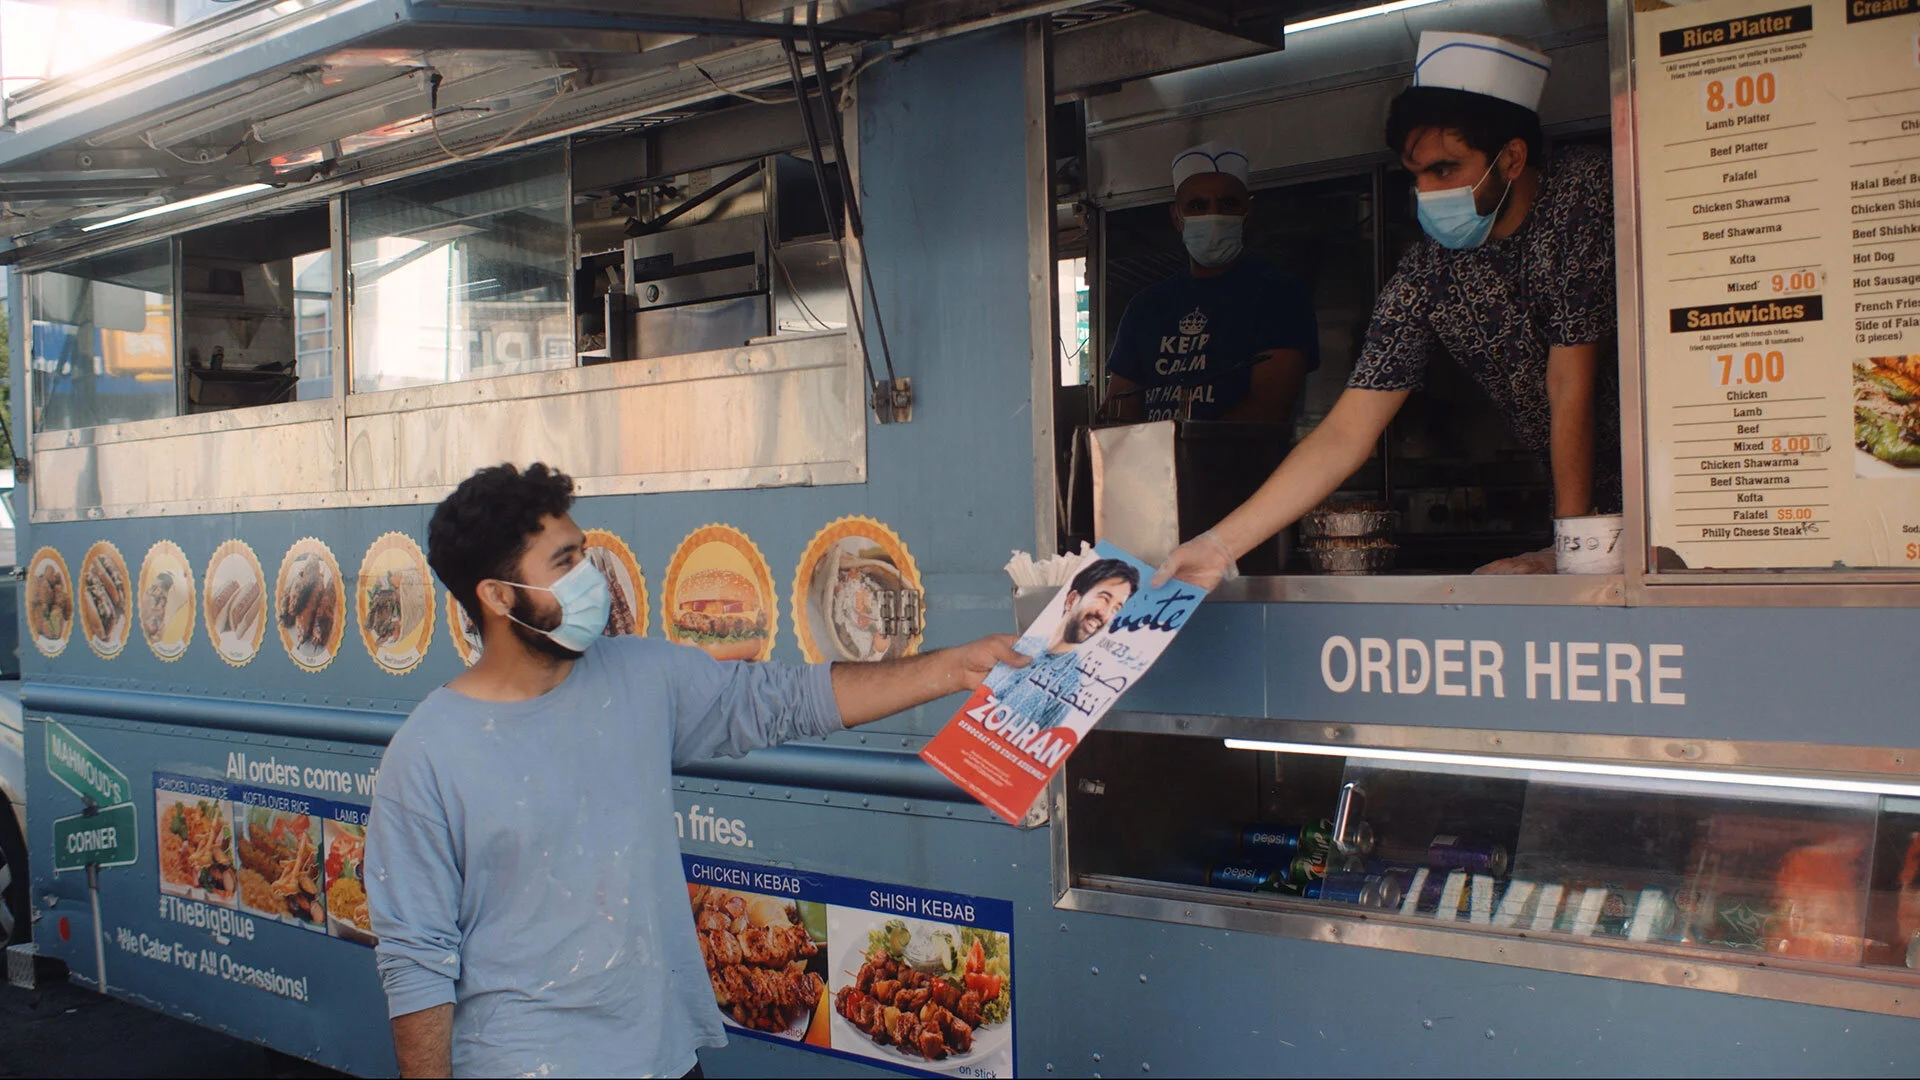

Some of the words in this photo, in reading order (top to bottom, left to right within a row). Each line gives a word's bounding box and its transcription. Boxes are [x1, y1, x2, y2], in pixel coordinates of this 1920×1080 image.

[1683, 31, 1724, 48] Rice
[1730, 14, 1793, 40] Platter
[1717, 55, 1737, 64] brown
[1746, 48, 1768, 59] yellow
[1706, 72, 1775, 112] 8.00
[1706, 118, 1735, 131] Lamb
[1737, 113, 1770, 127] Platter
[1710, 147, 1732, 158] Beef
[1735, 141, 1768, 153] Platter
[1722, 170, 1757, 183] Falafel
[1850, 179, 1879, 191] Halal
[1882, 174, 1906, 187] Beef
[1692, 201, 1733, 215] Chicken
[1735, 194, 1790, 209] Shawarma
[1851, 201, 1895, 215] Chicken
[1702, 229, 1724, 241] Beef
[1727, 223, 1782, 238] Shawarma
[1852, 227, 1876, 239] Beef
[1729, 253, 1756, 265] Kofta
[1853, 253, 1871, 264] Hot
[1874, 251, 1895, 263] Dog
[1771, 272, 1815, 293] 9.00
[1853, 278, 1871, 289] Hot
[1873, 274, 1920, 287] Sausage
[1854, 300, 1893, 313] French
[1687, 304, 1804, 329] Sandwiches
[1855, 320, 1878, 331] Side
[1882, 319, 1892, 330] of
[1751, 329, 1772, 337] french
[1855, 334, 1865, 345] (3
[1868, 330, 1903, 344] pieces)
[1155, 354, 1206, 376] CALM
[1717, 350, 1785, 386] 7.00
[1160, 385, 1215, 403] HAAL
[1726, 389, 1768, 401] Chicken
[1733, 407, 1763, 418] Lamb
[1737, 424, 1760, 435] Beef
[1733, 441, 1764, 452] Mixed
[1771, 436, 1810, 453] 8.00
[1700, 459, 1741, 470] Chicken
[1743, 457, 1799, 469] Shawarma
[1710, 476, 1732, 487] Beef
[1735, 475, 1790, 486] Shawarma
[1737, 492, 1763, 503] Kofta
[1733, 509, 1768, 521] Falafel
[1777, 508, 1811, 520] $5.00
[1702, 526, 1731, 540] Philly
[1733, 526, 1770, 537] Cheese
[1773, 525, 1802, 537] Steak
[1108, 588, 1195, 634] vote
[1111, 643, 1130, 658] 23
[1321, 635, 1505, 698] ORDER
[1525, 641, 1686, 705] HERE
[966, 694, 1072, 769] ZOHRAN
[957, 719, 991, 746] DEMOCRAT
[988, 739, 1002, 753] FOR
[1000, 748, 1019, 764] STATE
[226, 751, 246, 780] All
[249, 756, 300, 787] orders
[303, 767, 353, 794] come
[158, 777, 190, 794] CHICKEN
[190, 781, 210, 797] OVER
[211, 785, 229, 800] RICE
[242, 791, 267, 807] KOFTA
[268, 796, 289, 811] OVER
[290, 799, 310, 815] RICE
[335, 807, 359, 824] LAMB
[689, 804, 754, 848] fries.
[67, 826, 118, 854] CORNER
[1252, 831, 1286, 846] pepsi
[692, 863, 750, 887] CHICKEN
[754, 872, 801, 893] KEBAB
[1222, 866, 1258, 880] pepsi
[870, 890, 917, 914] SHISH
[922, 899, 976, 922] KEBAB
[159, 894, 255, 940] #TheBigBlue
[116, 926, 139, 953] We
[139, 933, 172, 963] Cater
[173, 942, 198, 970] For
[200, 949, 218, 976] All
[219, 954, 309, 1002] Occassions!
[959, 1063, 972, 1076] on
[975, 1066, 997, 1079] stick
